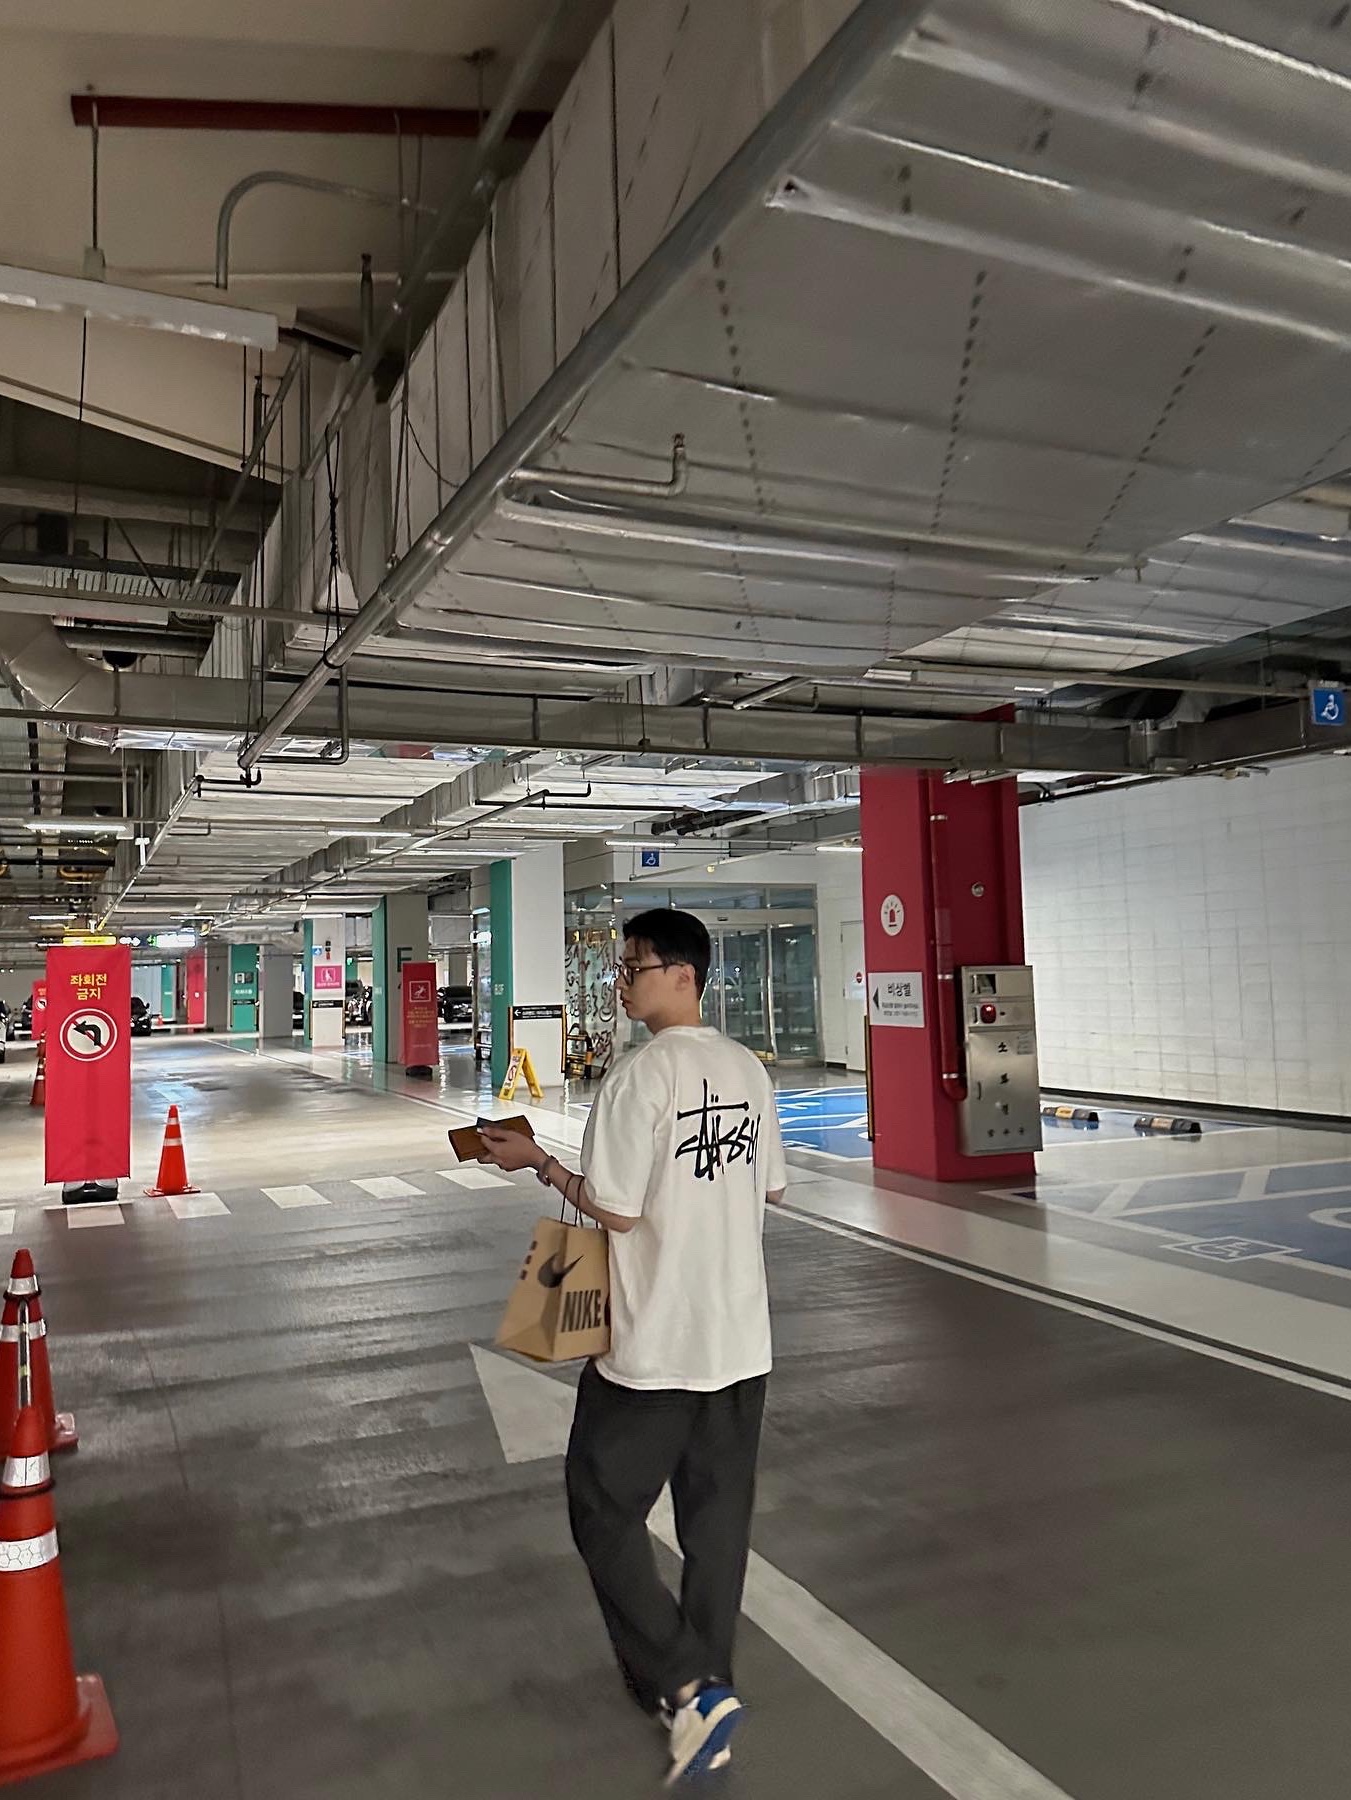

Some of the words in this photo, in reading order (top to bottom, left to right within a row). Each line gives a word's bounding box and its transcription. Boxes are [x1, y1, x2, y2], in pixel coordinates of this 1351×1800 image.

[70, 973, 107, 986] 좌회전
[76, 987, 101, 1000] 금지
[561, 1289, 602, 1333] NIKE
